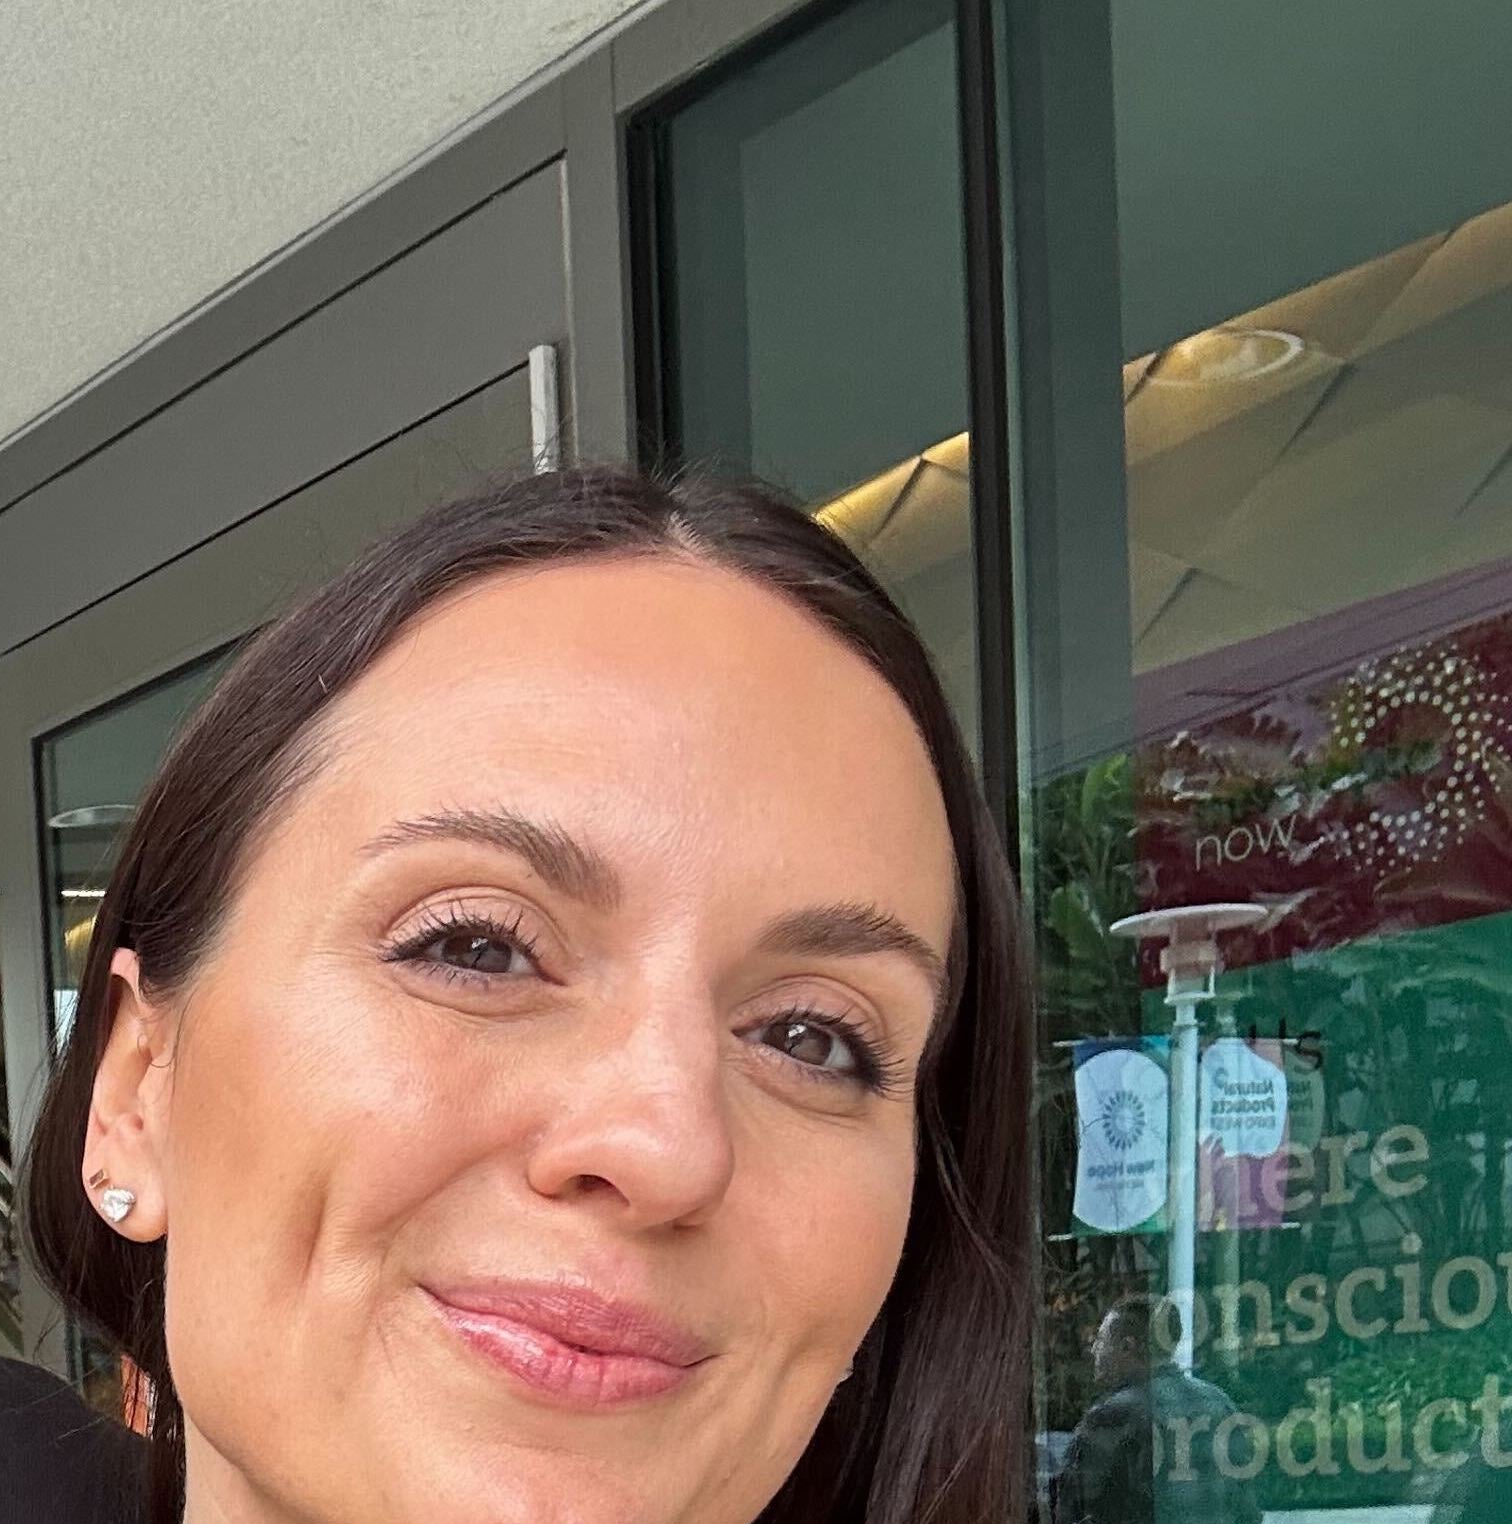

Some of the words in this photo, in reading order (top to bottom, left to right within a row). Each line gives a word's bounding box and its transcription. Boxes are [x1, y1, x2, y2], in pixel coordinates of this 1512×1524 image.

[1194, 818, 1296, 872] now
[1150, 1235, 1512, 1354] onscio
[1152, 1373, 1512, 1481] roduct
